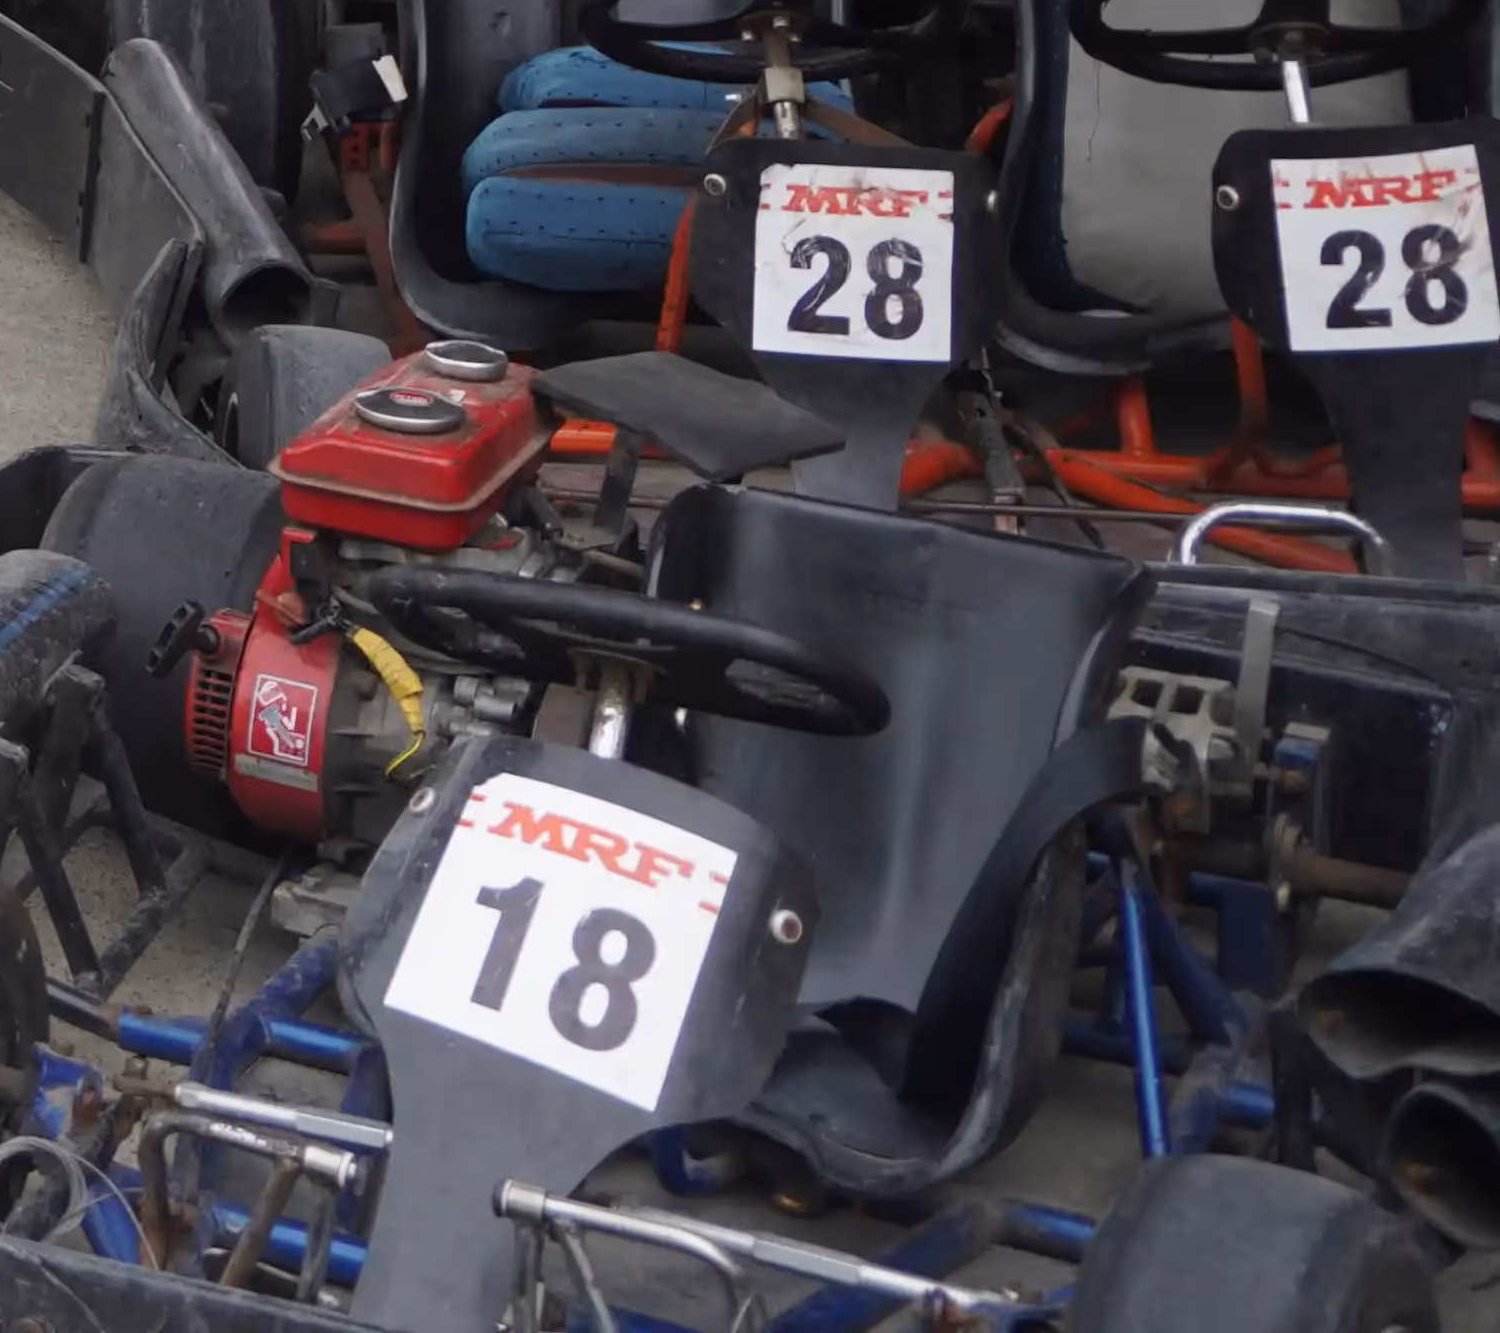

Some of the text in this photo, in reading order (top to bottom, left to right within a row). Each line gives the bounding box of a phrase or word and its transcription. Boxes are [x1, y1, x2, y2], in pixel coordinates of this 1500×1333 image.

[781, 185, 929, 218] MRF
[1304, 169, 1455, 209] MRF
[787, 236, 924, 341] 28
[1320, 224, 1469, 329] 28
[487, 801, 695, 889] MRF
[470, 876, 656, 1052] 18
